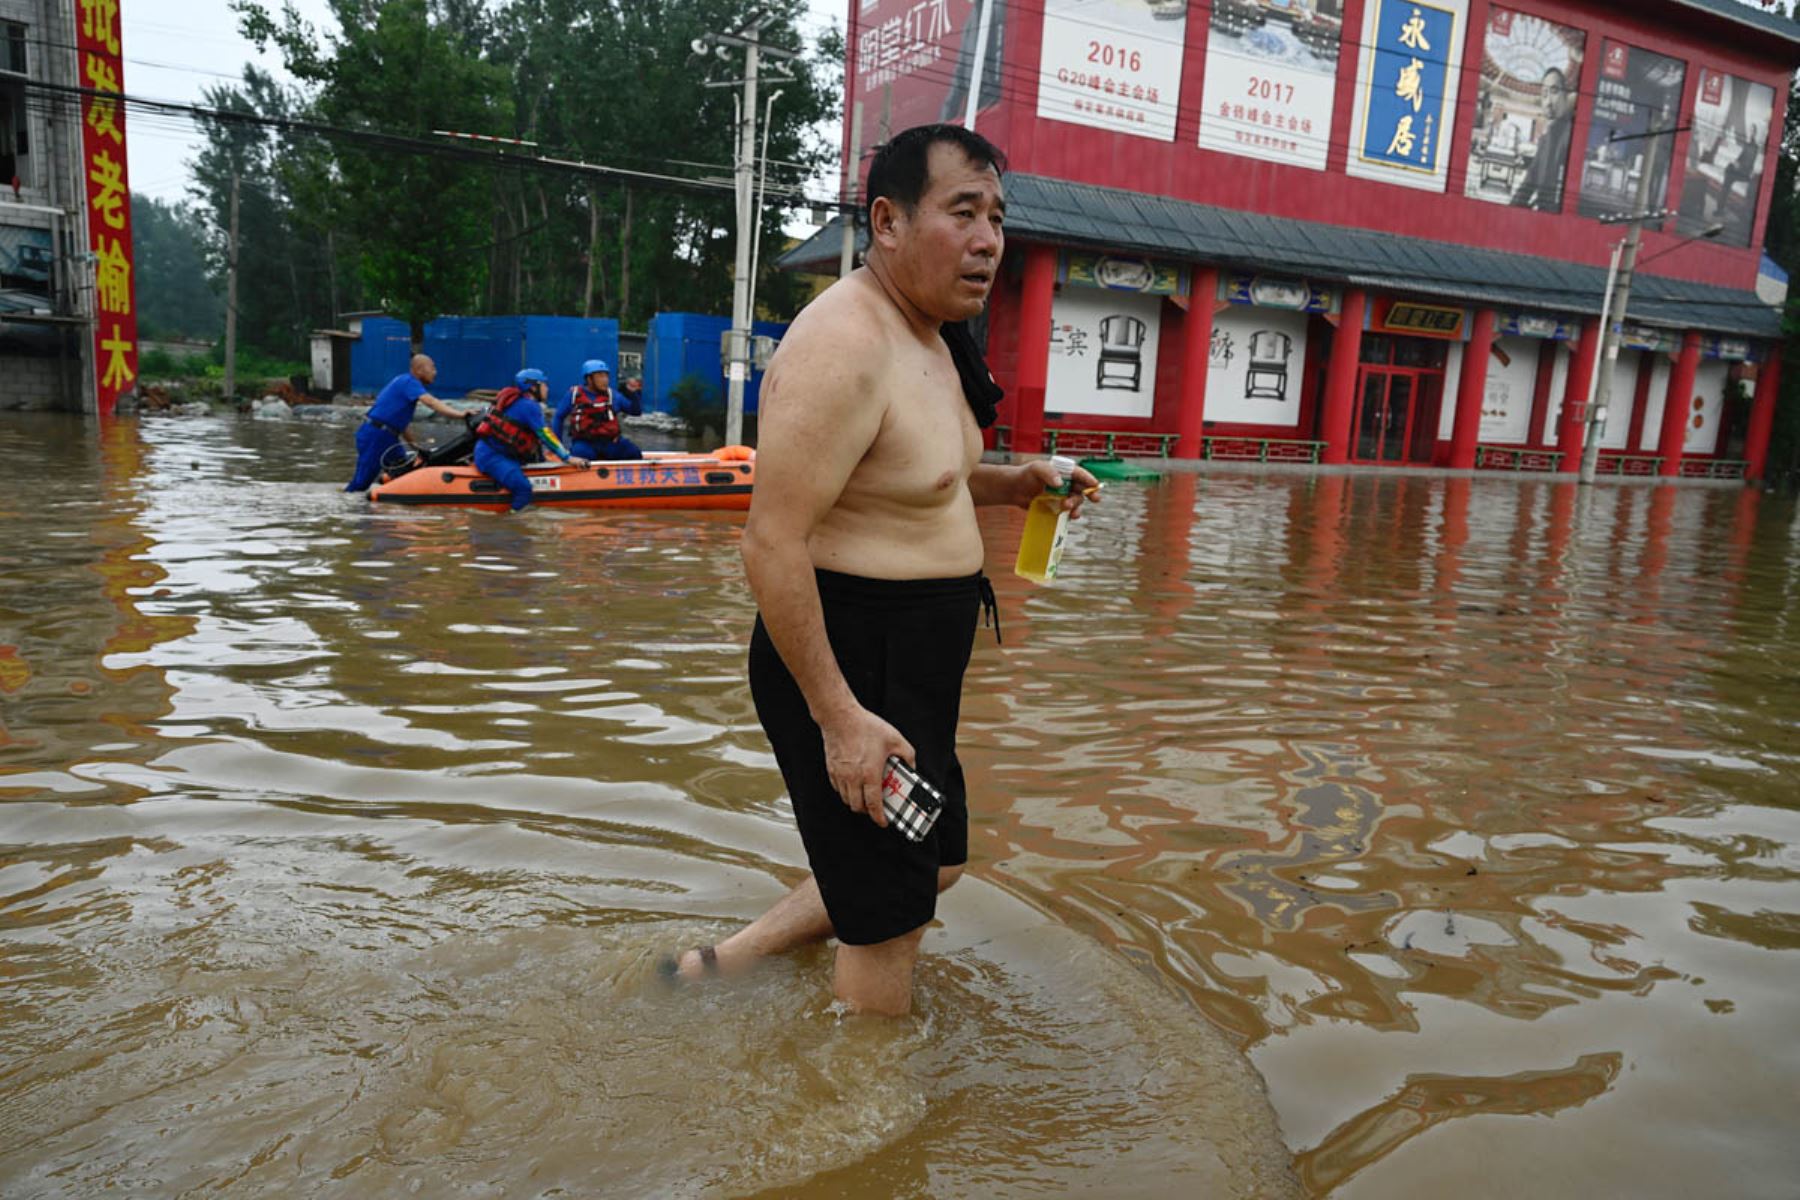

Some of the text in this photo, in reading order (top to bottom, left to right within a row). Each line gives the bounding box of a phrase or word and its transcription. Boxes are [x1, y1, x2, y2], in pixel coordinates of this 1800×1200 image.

[1087, 40, 1142, 72] 2016
[1057, 67, 1160, 105] G20峰会主会场
[1247, 76, 1294, 105] 2017
[1219, 101, 1312, 134] 金砖峰会主会场
